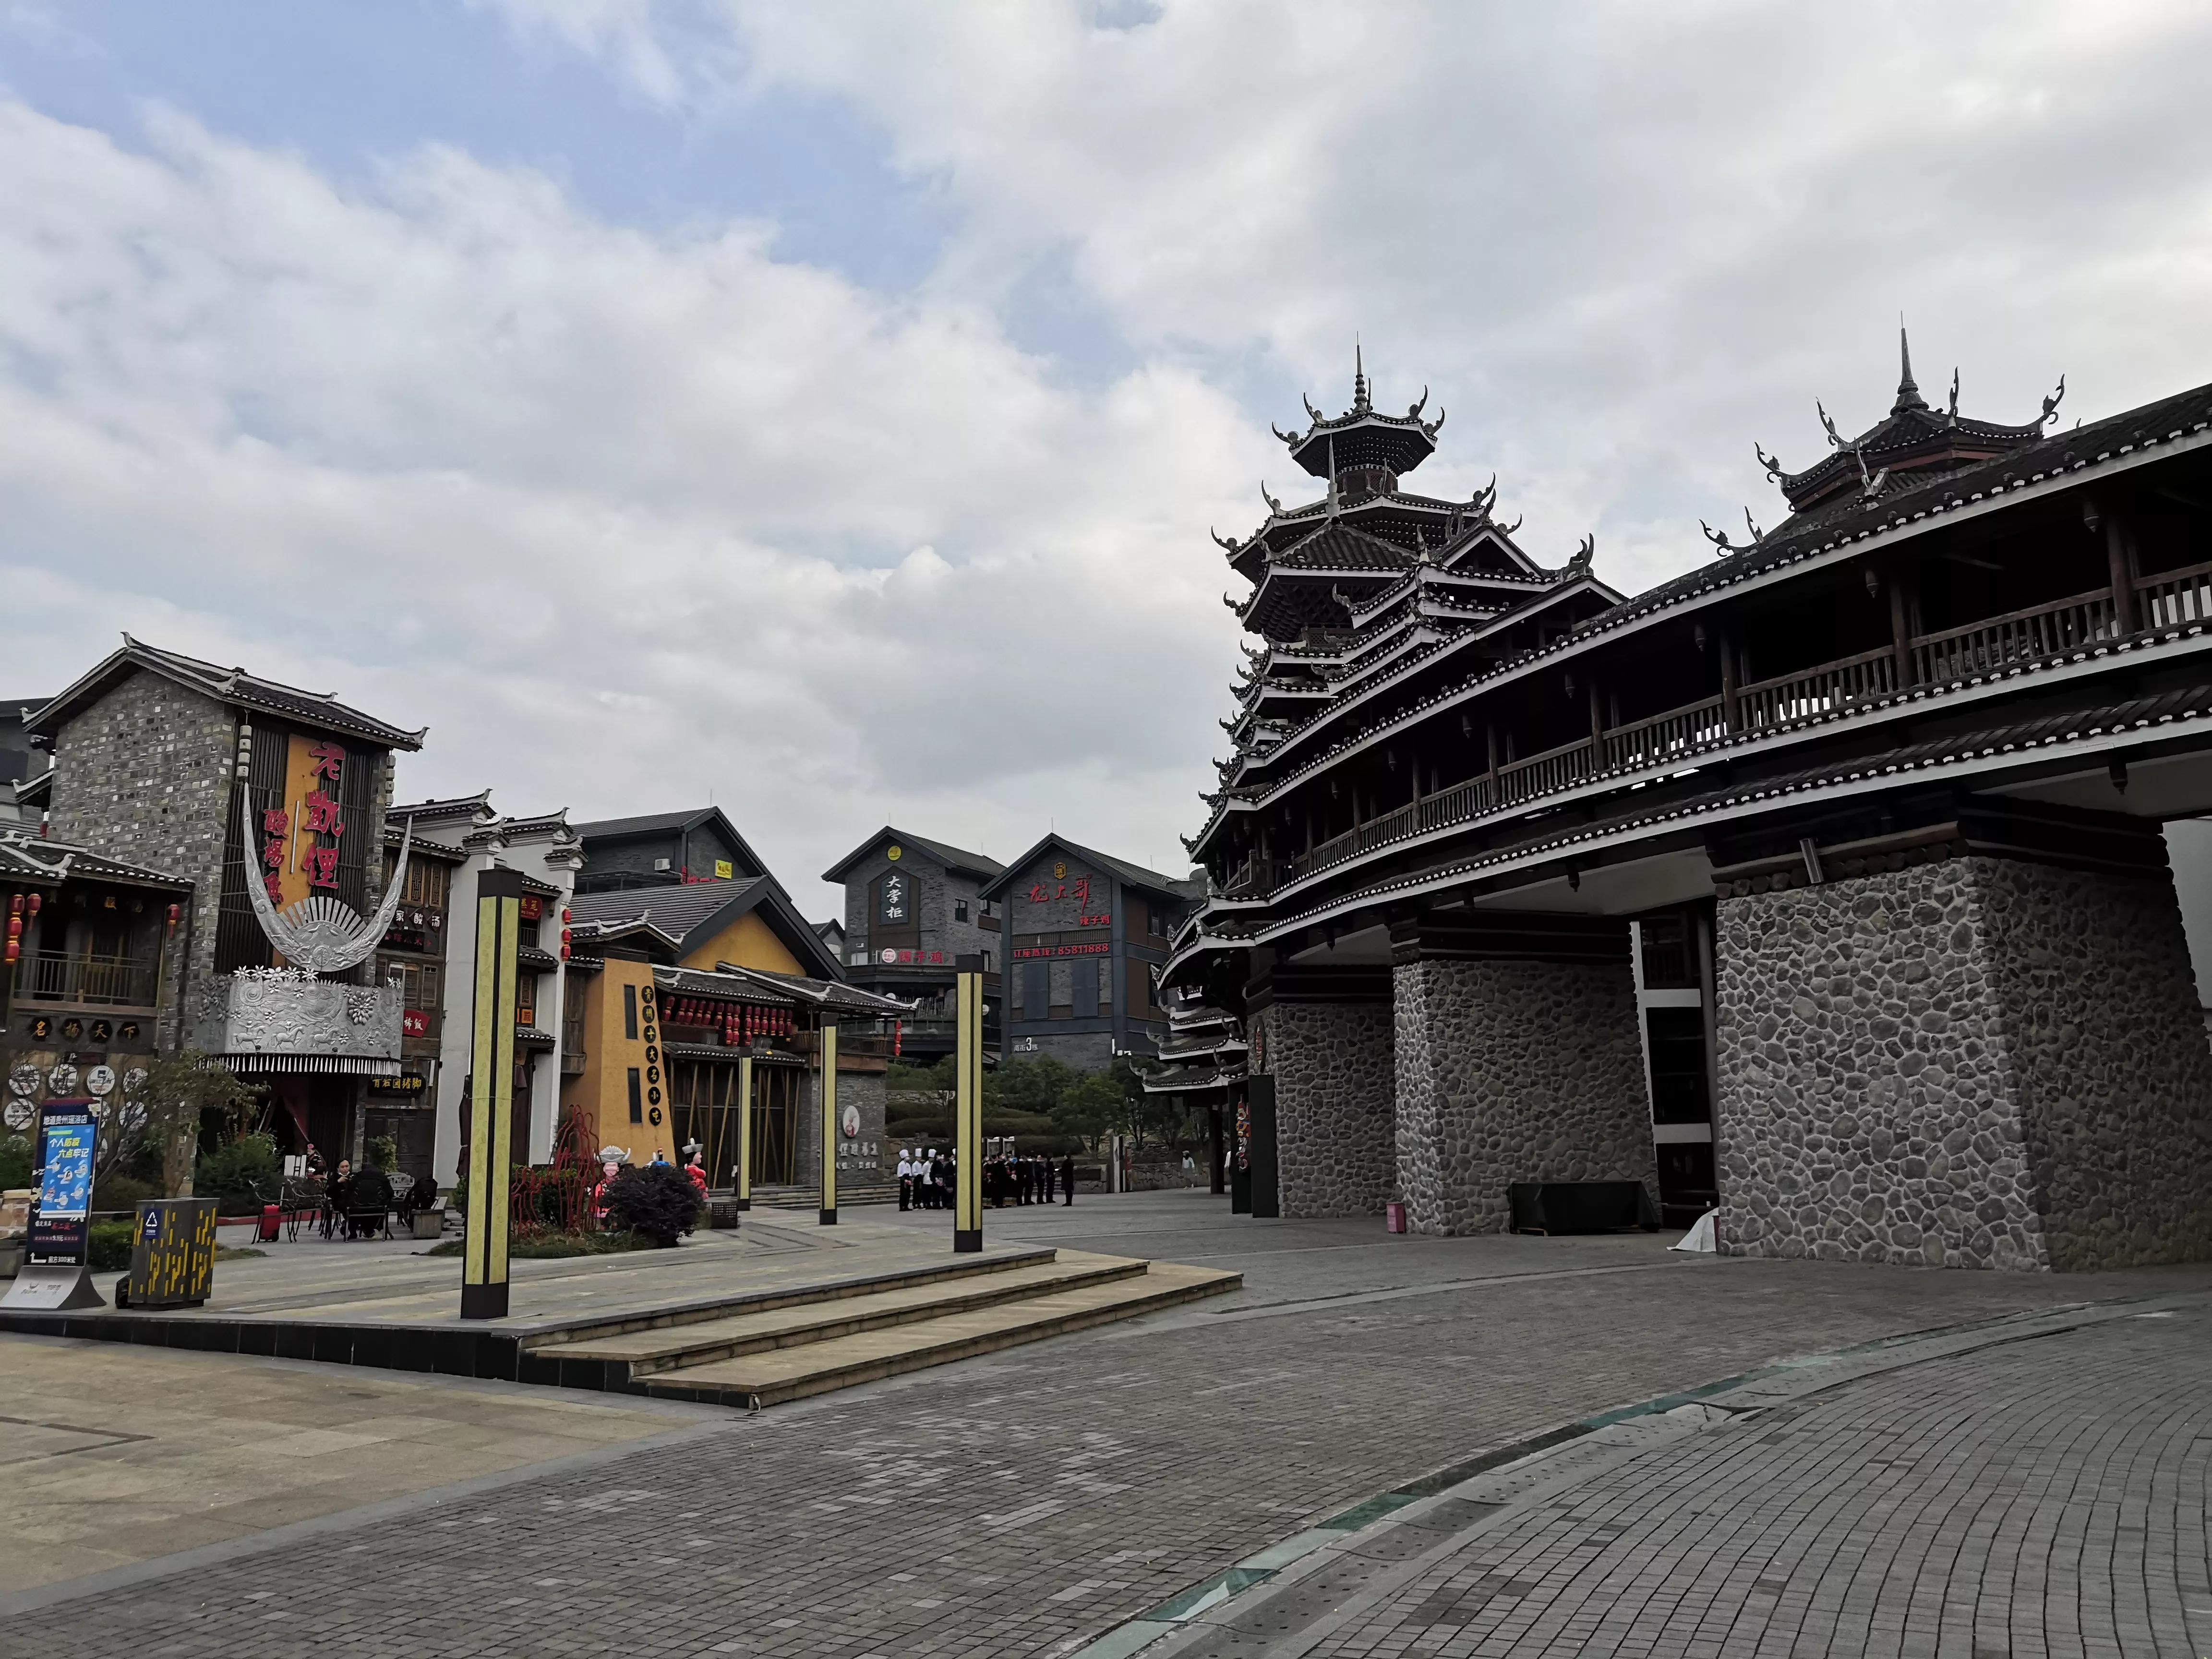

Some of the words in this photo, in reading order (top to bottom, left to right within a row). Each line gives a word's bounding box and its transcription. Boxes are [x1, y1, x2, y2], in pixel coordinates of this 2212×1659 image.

[886, 876, 903, 919] 大掌柜
[1030, 874, 1093, 914] 龙大哥
[1080, 914, 1110, 926] 辣子鸡
[31, 1020, 136, 1040] 名扬天下
[49, 1137, 81, 1147] 个人防疫
[58, 1148, 89, 1158] 六点牢记
